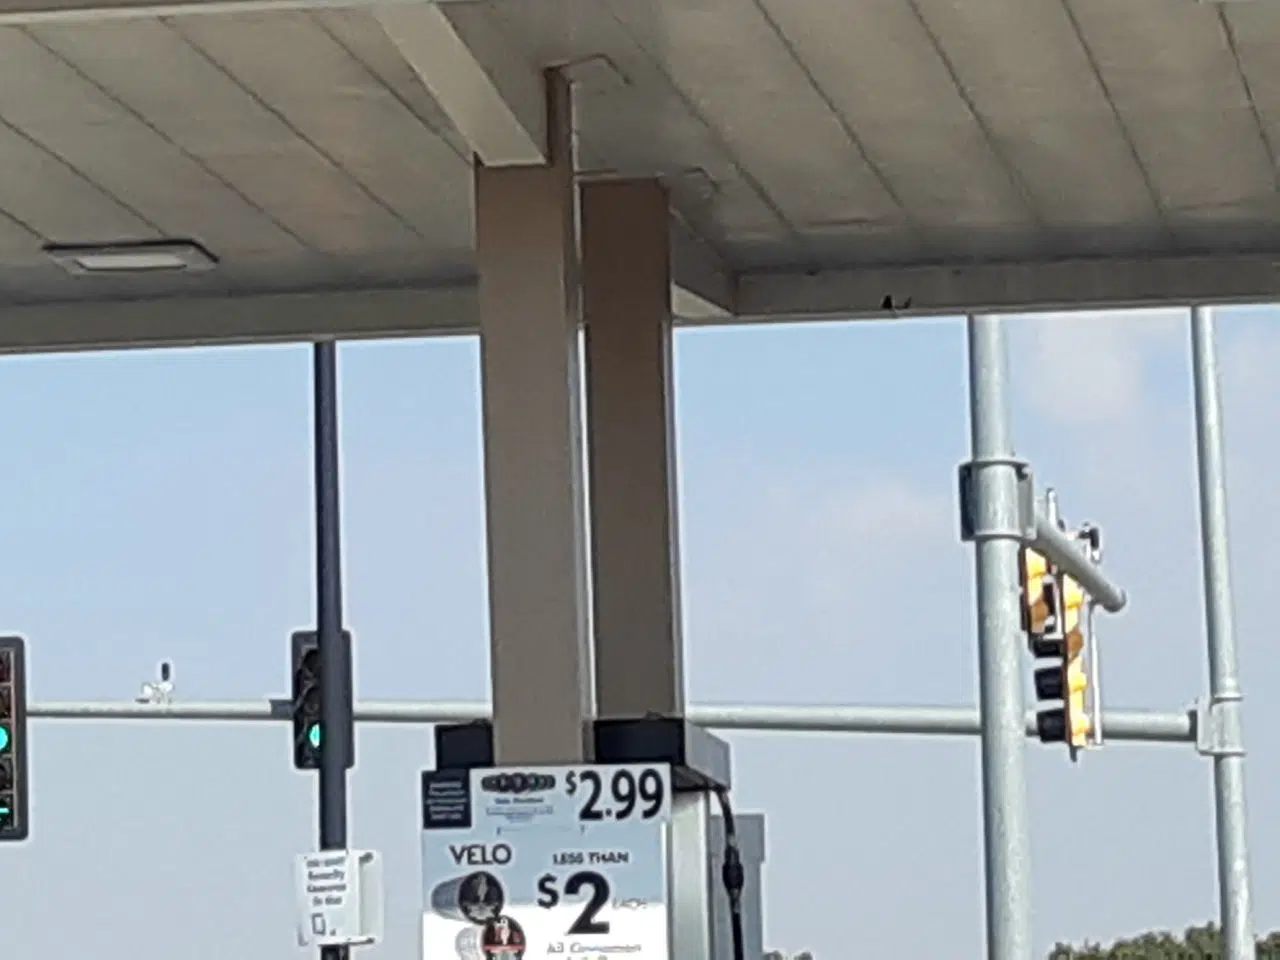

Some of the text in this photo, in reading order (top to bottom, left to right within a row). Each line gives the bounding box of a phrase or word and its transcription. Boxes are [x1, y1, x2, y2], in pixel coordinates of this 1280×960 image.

[565, 768, 664, 821] $2.99
[449, 843, 512, 866] VELO
[552, 851, 629, 865] LESS THAN
[537, 870, 610, 935] $2
